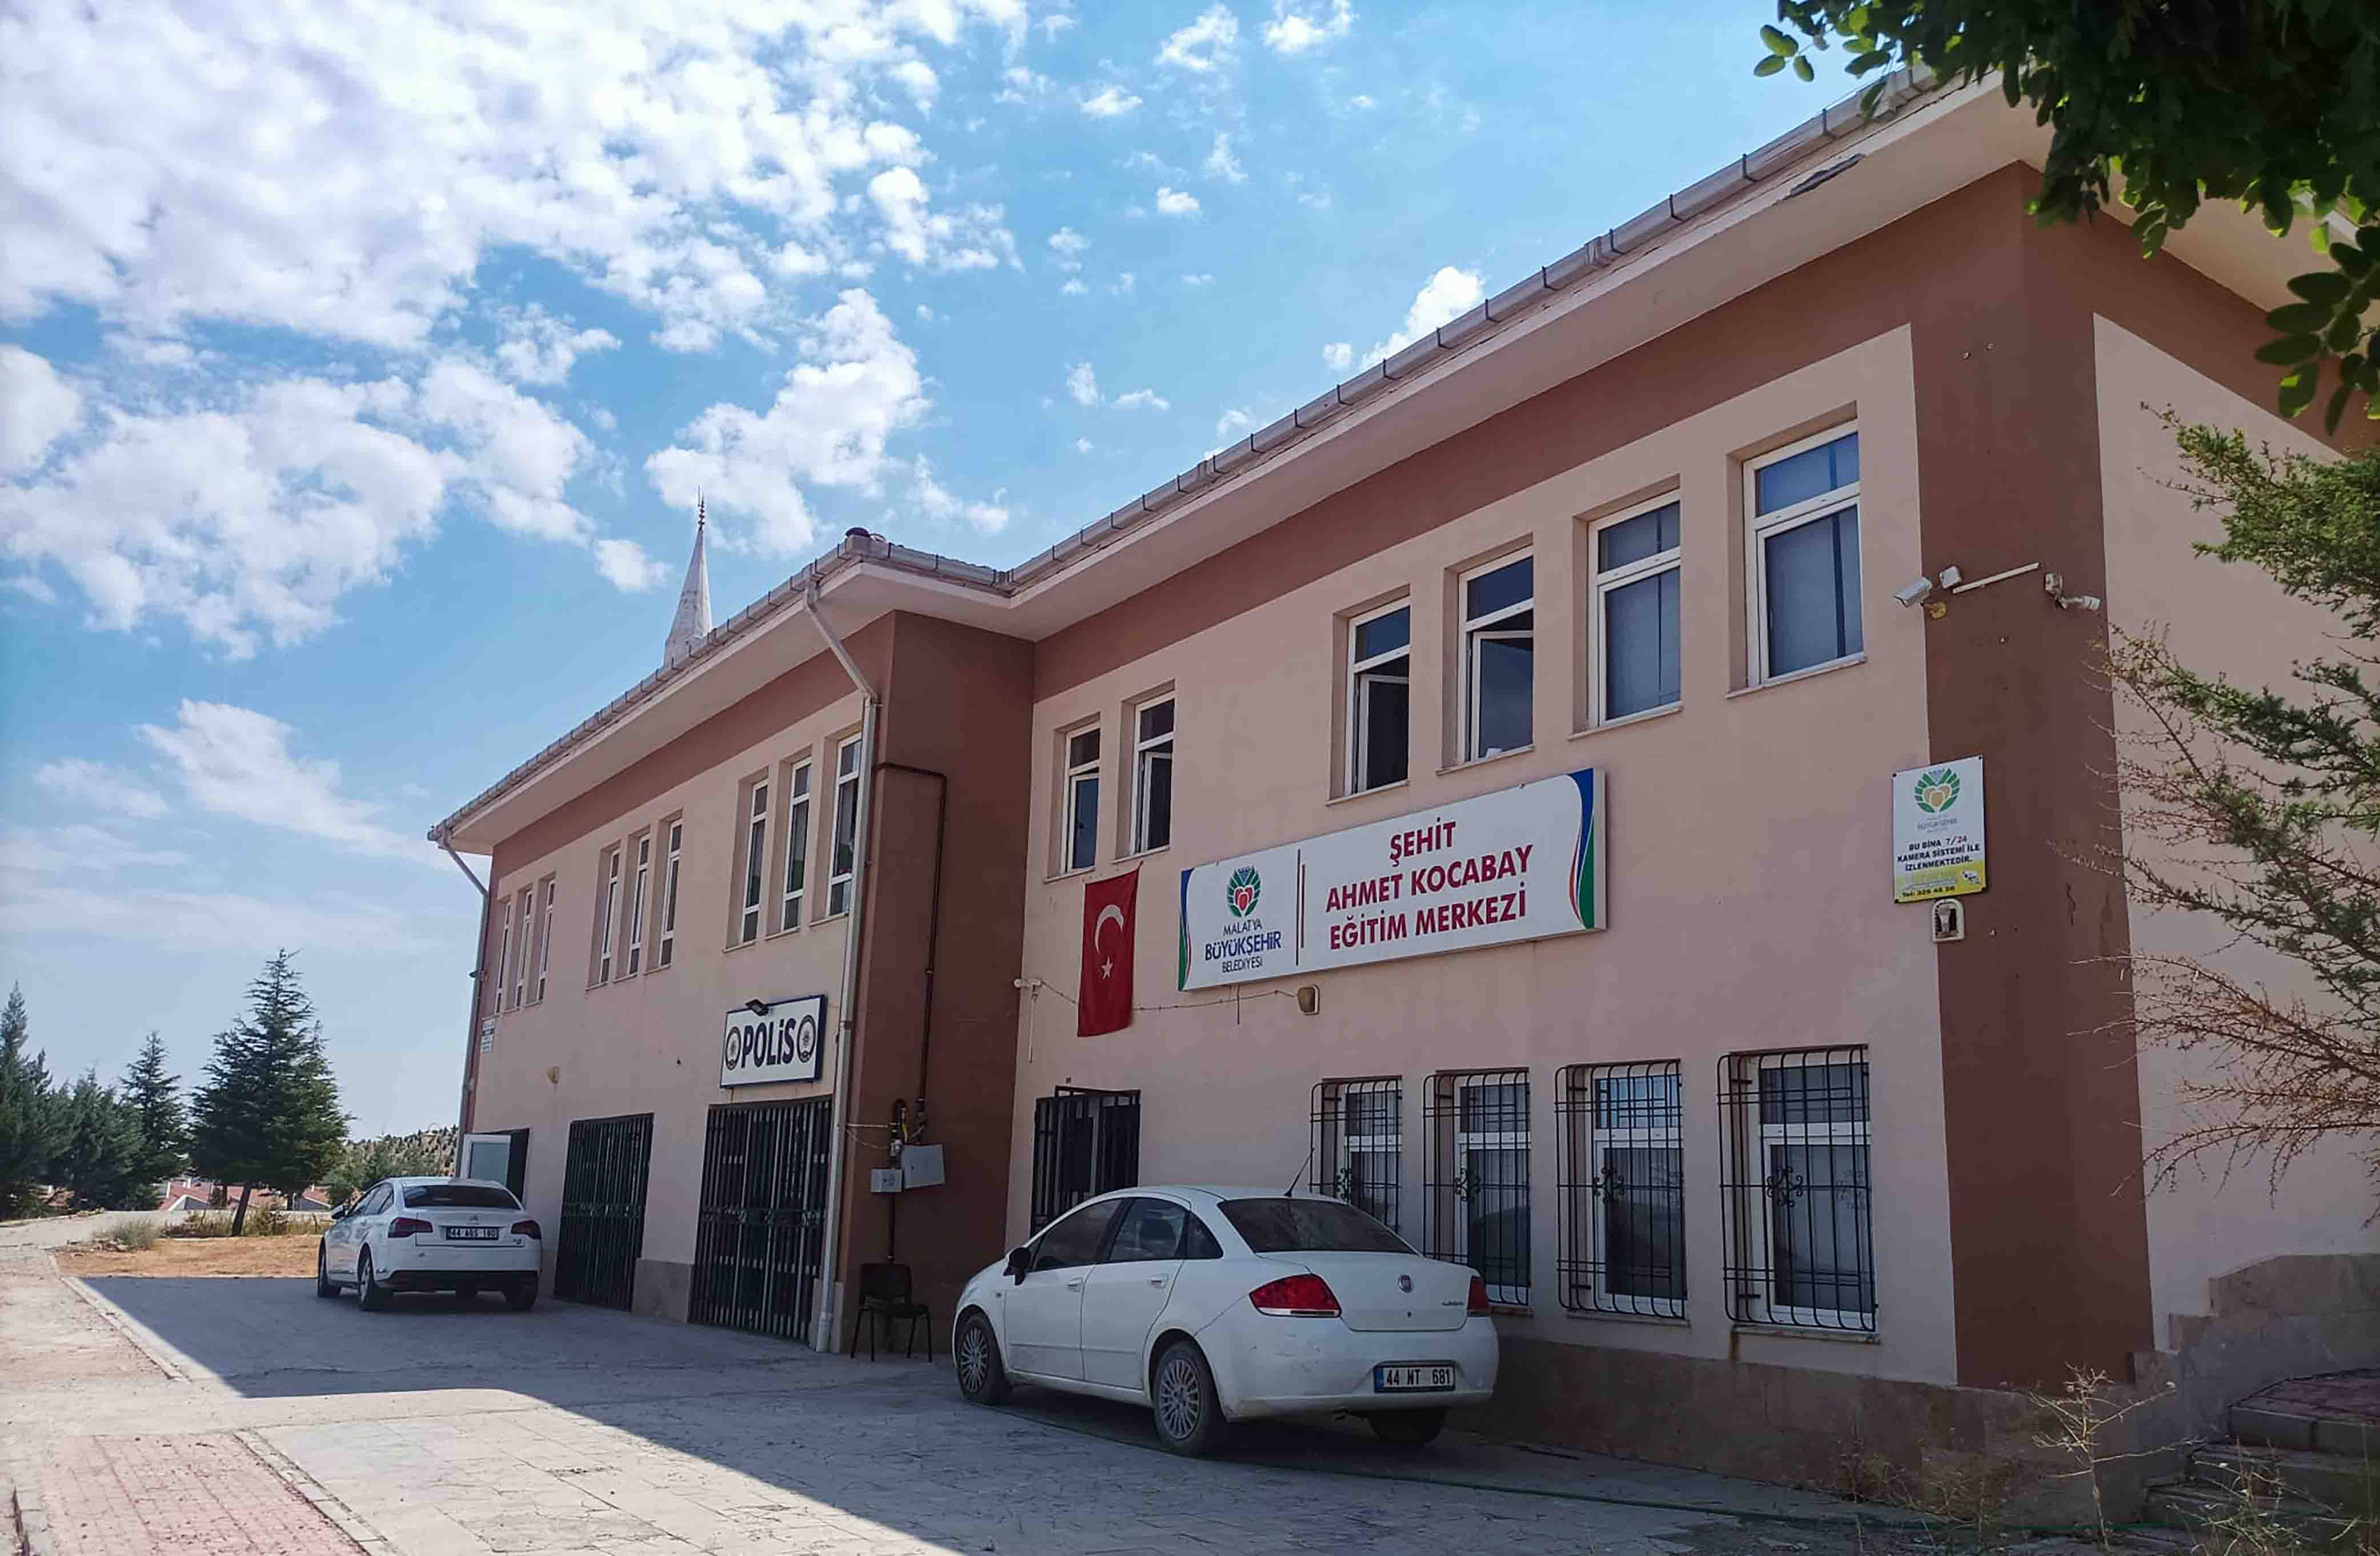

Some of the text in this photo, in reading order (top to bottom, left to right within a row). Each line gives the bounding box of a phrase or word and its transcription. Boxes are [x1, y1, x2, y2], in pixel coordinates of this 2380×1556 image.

[1390, 817, 1456, 867] ŞEHİT
[1909, 842, 1920, 851] BU
[1897, 851, 1930, 863] KAMERA
[1932, 844, 1965, 857] SİSTEMİ
[1326, 845, 1534, 913] AHMET KOCABAY
[1330, 881, 1526, 950] EĞİTİM MERKEZİ
[1223, 918, 1263, 936] MALATYA
[1386, 1369, 1450, 1385] 44 NT 681
